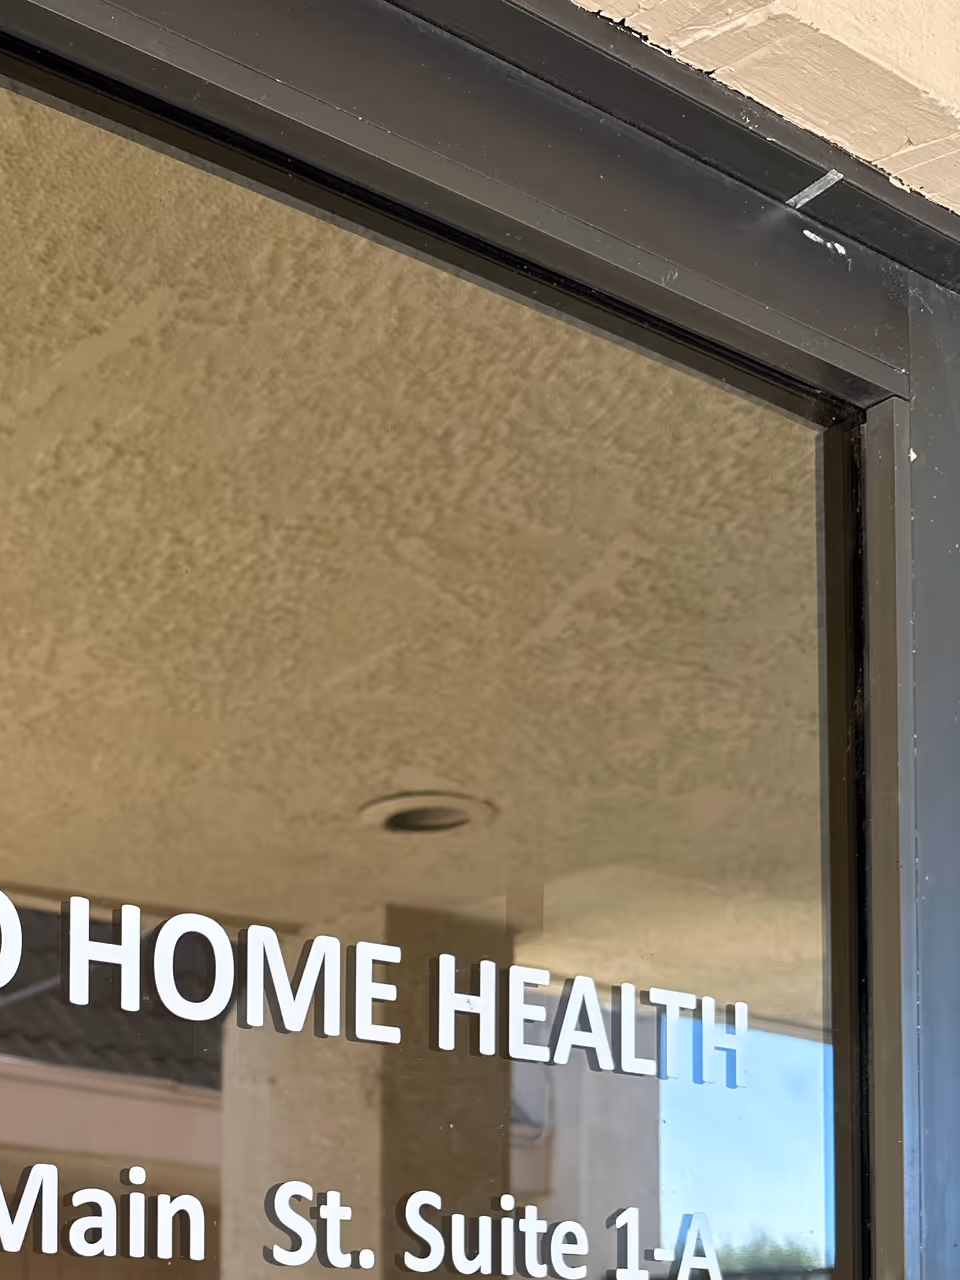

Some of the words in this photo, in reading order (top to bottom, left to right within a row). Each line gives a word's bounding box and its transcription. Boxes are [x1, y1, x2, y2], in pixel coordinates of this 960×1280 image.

[69, 896, 401, 1044] HOME
[438, 953, 749, 1088] HEALTH
[272, 1180, 375, 1269] St.
[402, 1190, 589, 1280] Suite
